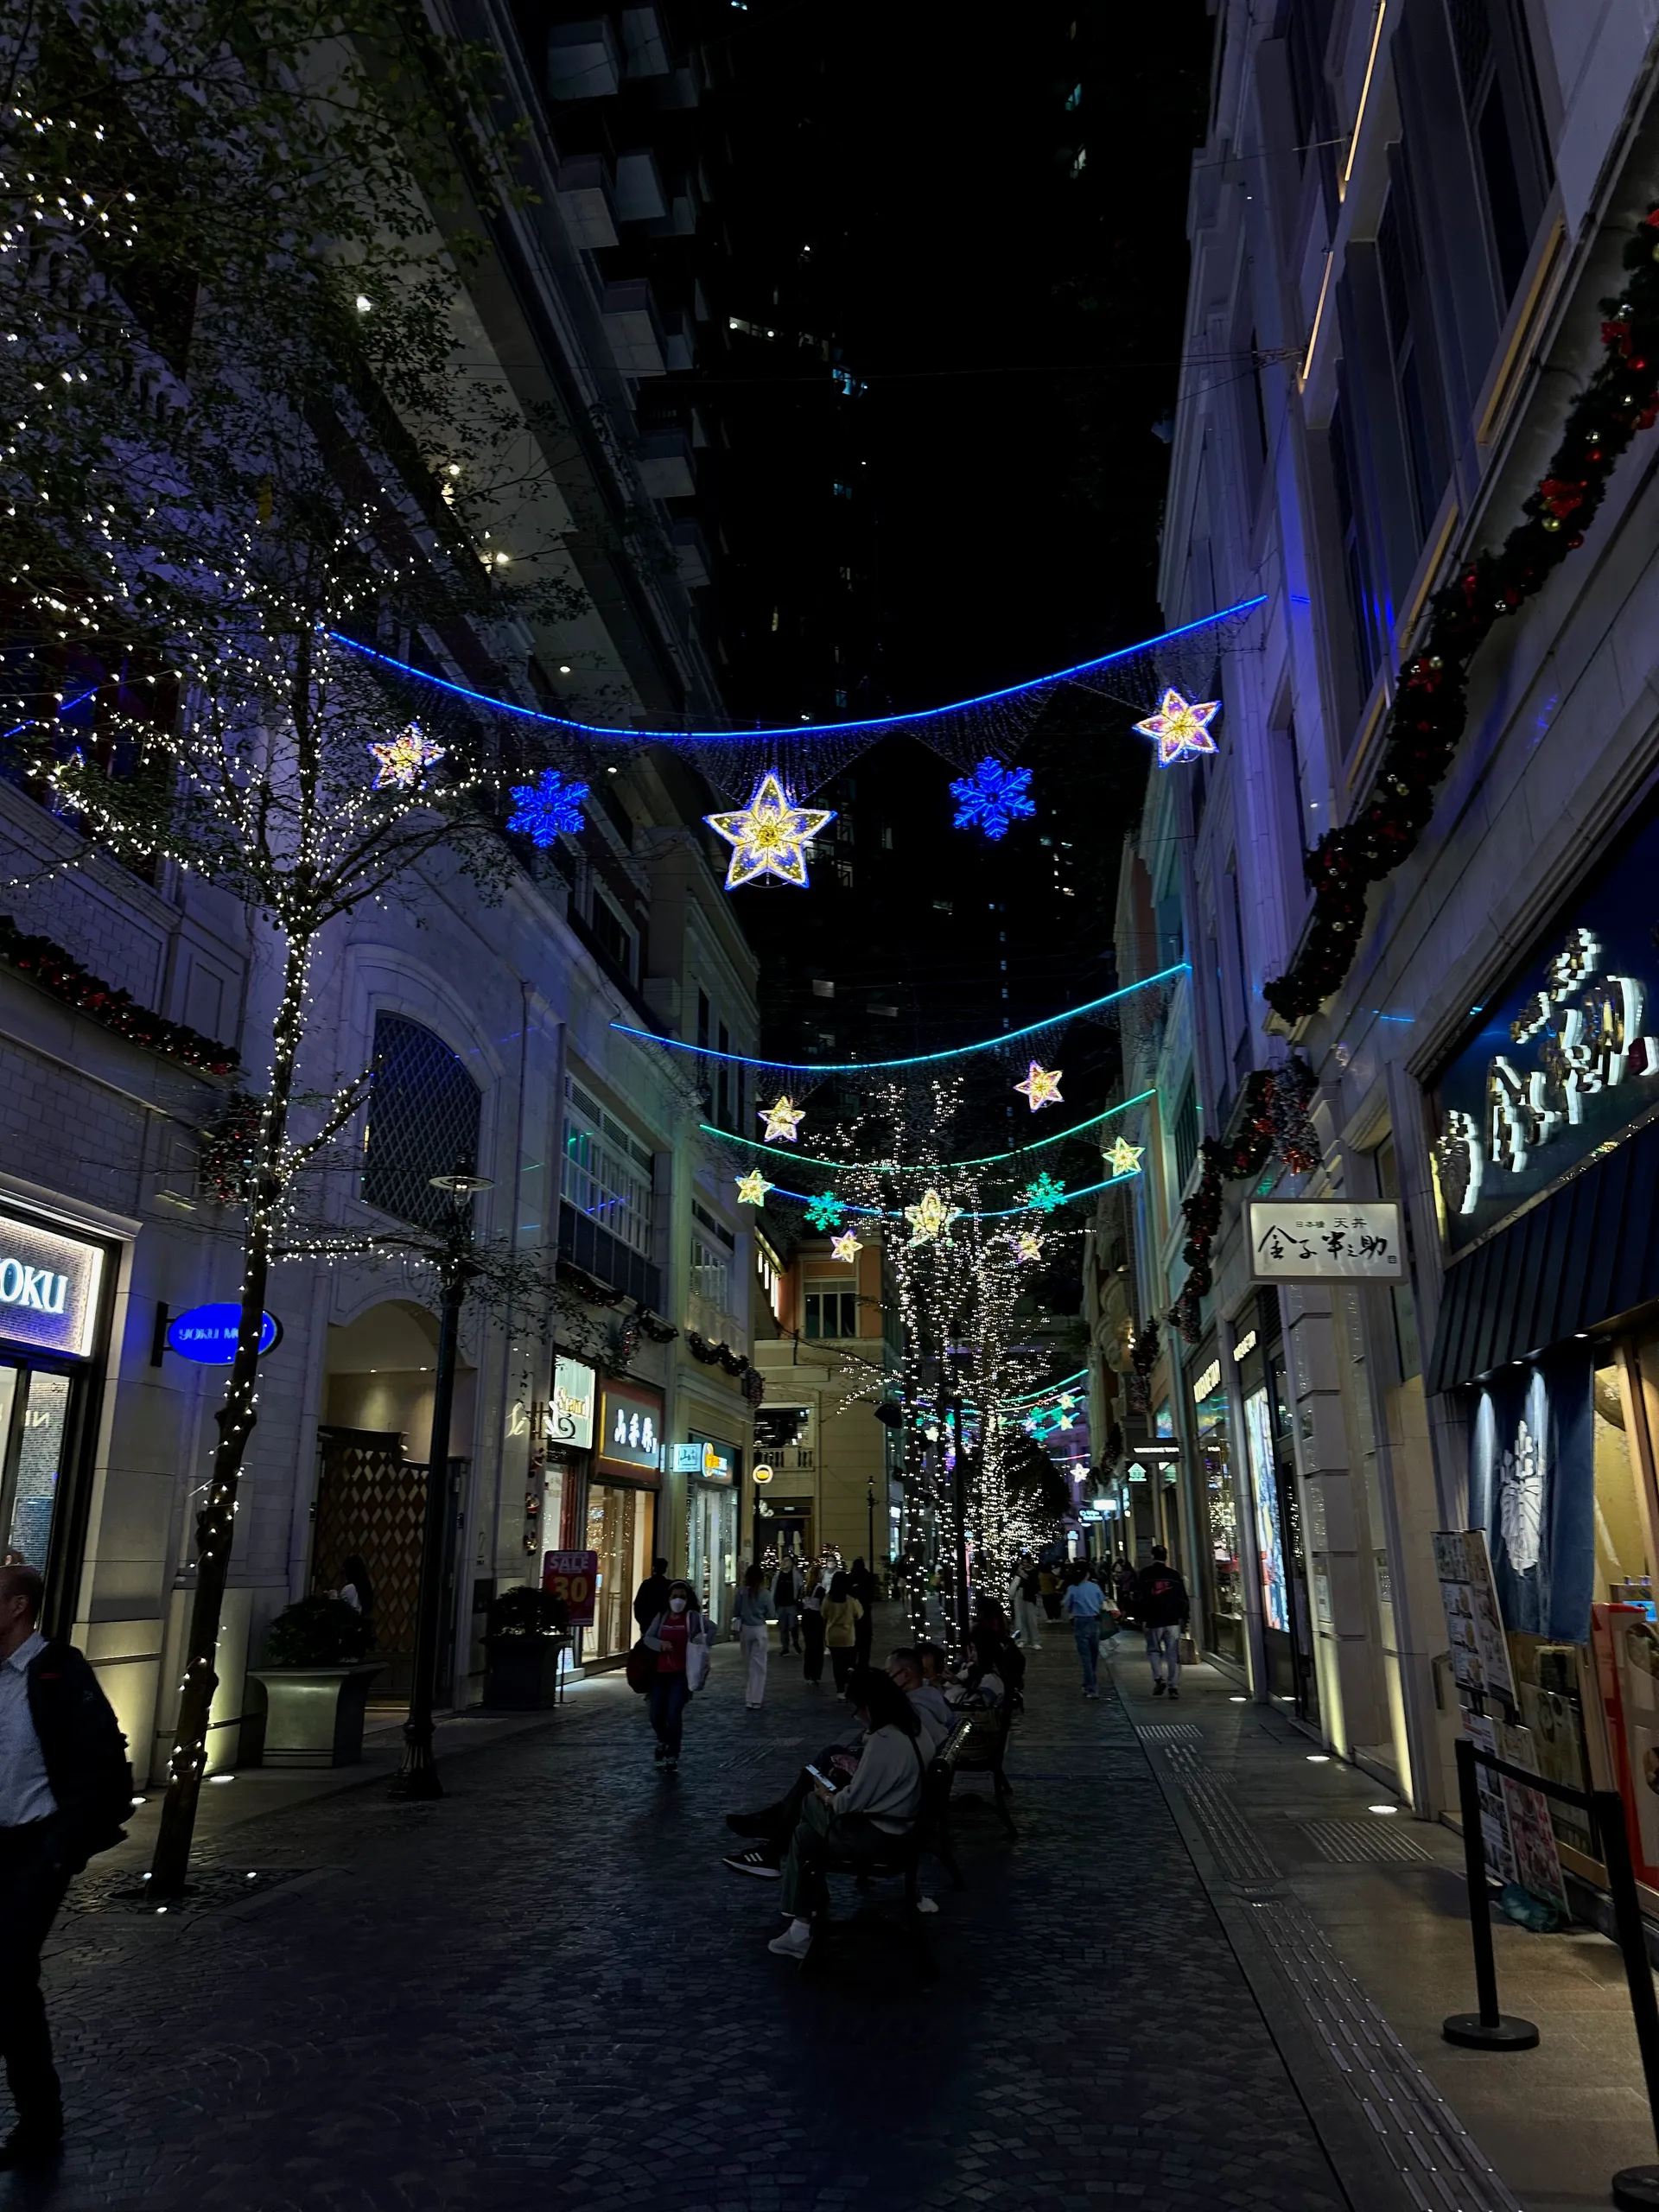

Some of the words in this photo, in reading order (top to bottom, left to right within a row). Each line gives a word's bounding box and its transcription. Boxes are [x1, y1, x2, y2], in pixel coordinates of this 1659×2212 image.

[178, 1327, 219, 1340] YOKU
[549, 1554, 589, 1570] SALE
[554, 1575, 588, 1603] 30
